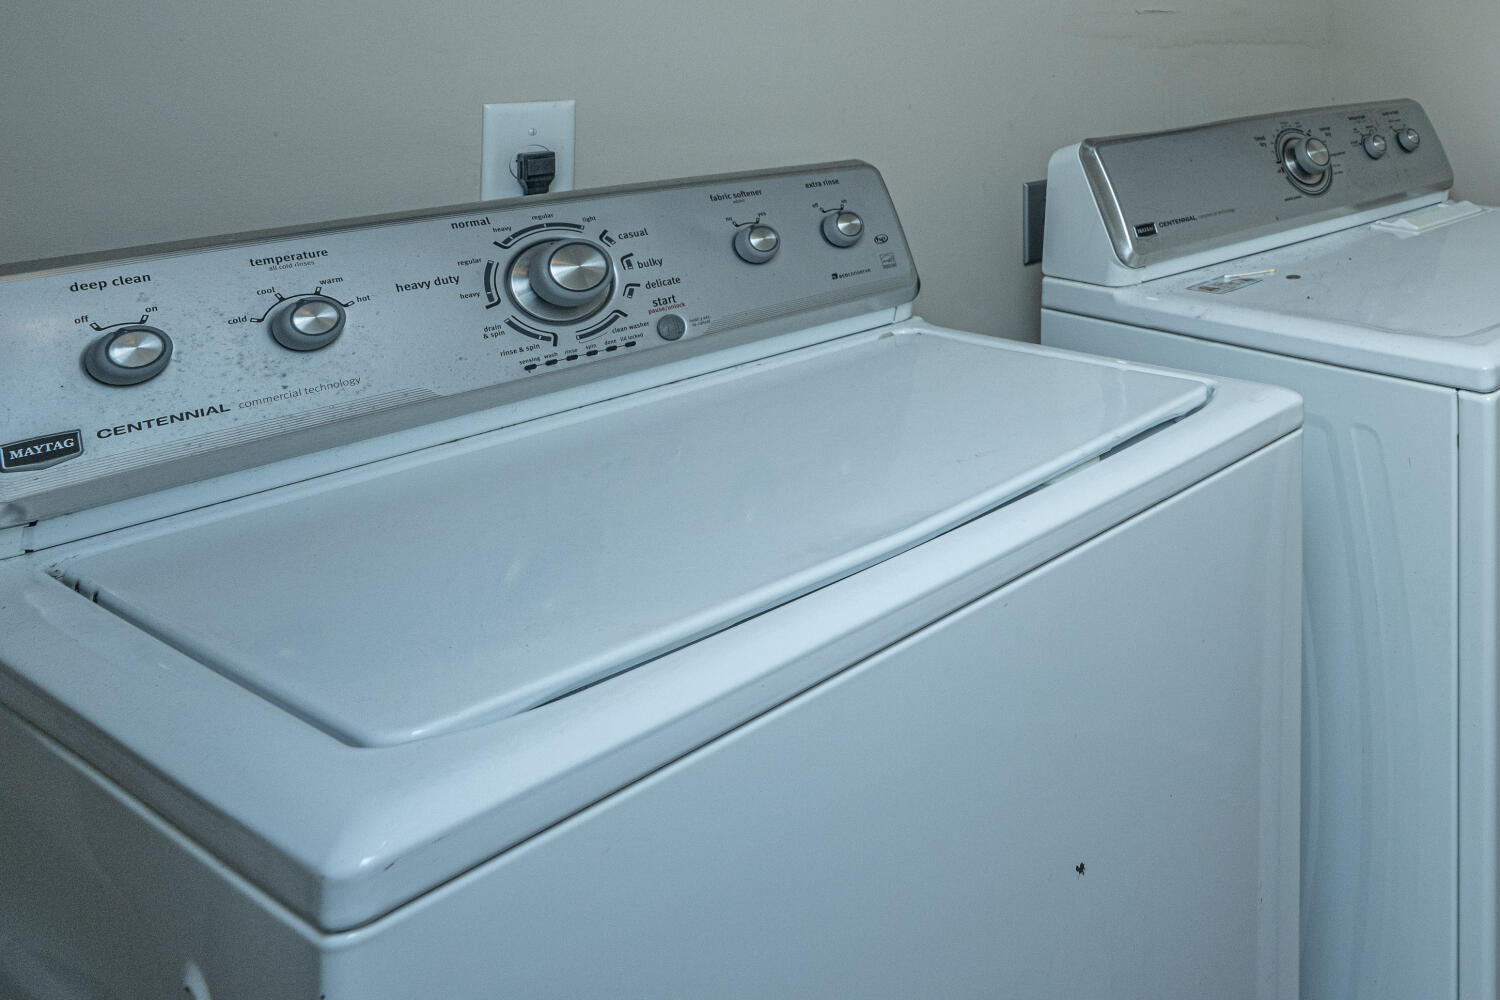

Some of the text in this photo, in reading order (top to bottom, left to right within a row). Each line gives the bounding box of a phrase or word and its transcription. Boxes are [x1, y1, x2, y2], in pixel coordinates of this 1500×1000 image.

[450, 217, 491, 230] normal
[618, 228, 649, 240] casual
[249, 248, 329, 266] temperature
[636, 258, 664, 270] bulky
[69, 273, 152, 293] deep clean
[319, 276, 344, 287] warm
[395, 274, 461, 294] heavy duty
[644, 276, 682, 291] delicate
[256, 286, 276, 297] cool
[356, 294, 371, 303] hot
[651, 295, 676, 308] start
[145, 304, 158, 314] on
[74, 314, 89, 325] off
[228, 316, 248, 325] cold
[238, 377, 362, 410] commercial technology
[96, 403, 232, 440] CENTENNIAL
[9, 438, 75, 460] MAYTAG
